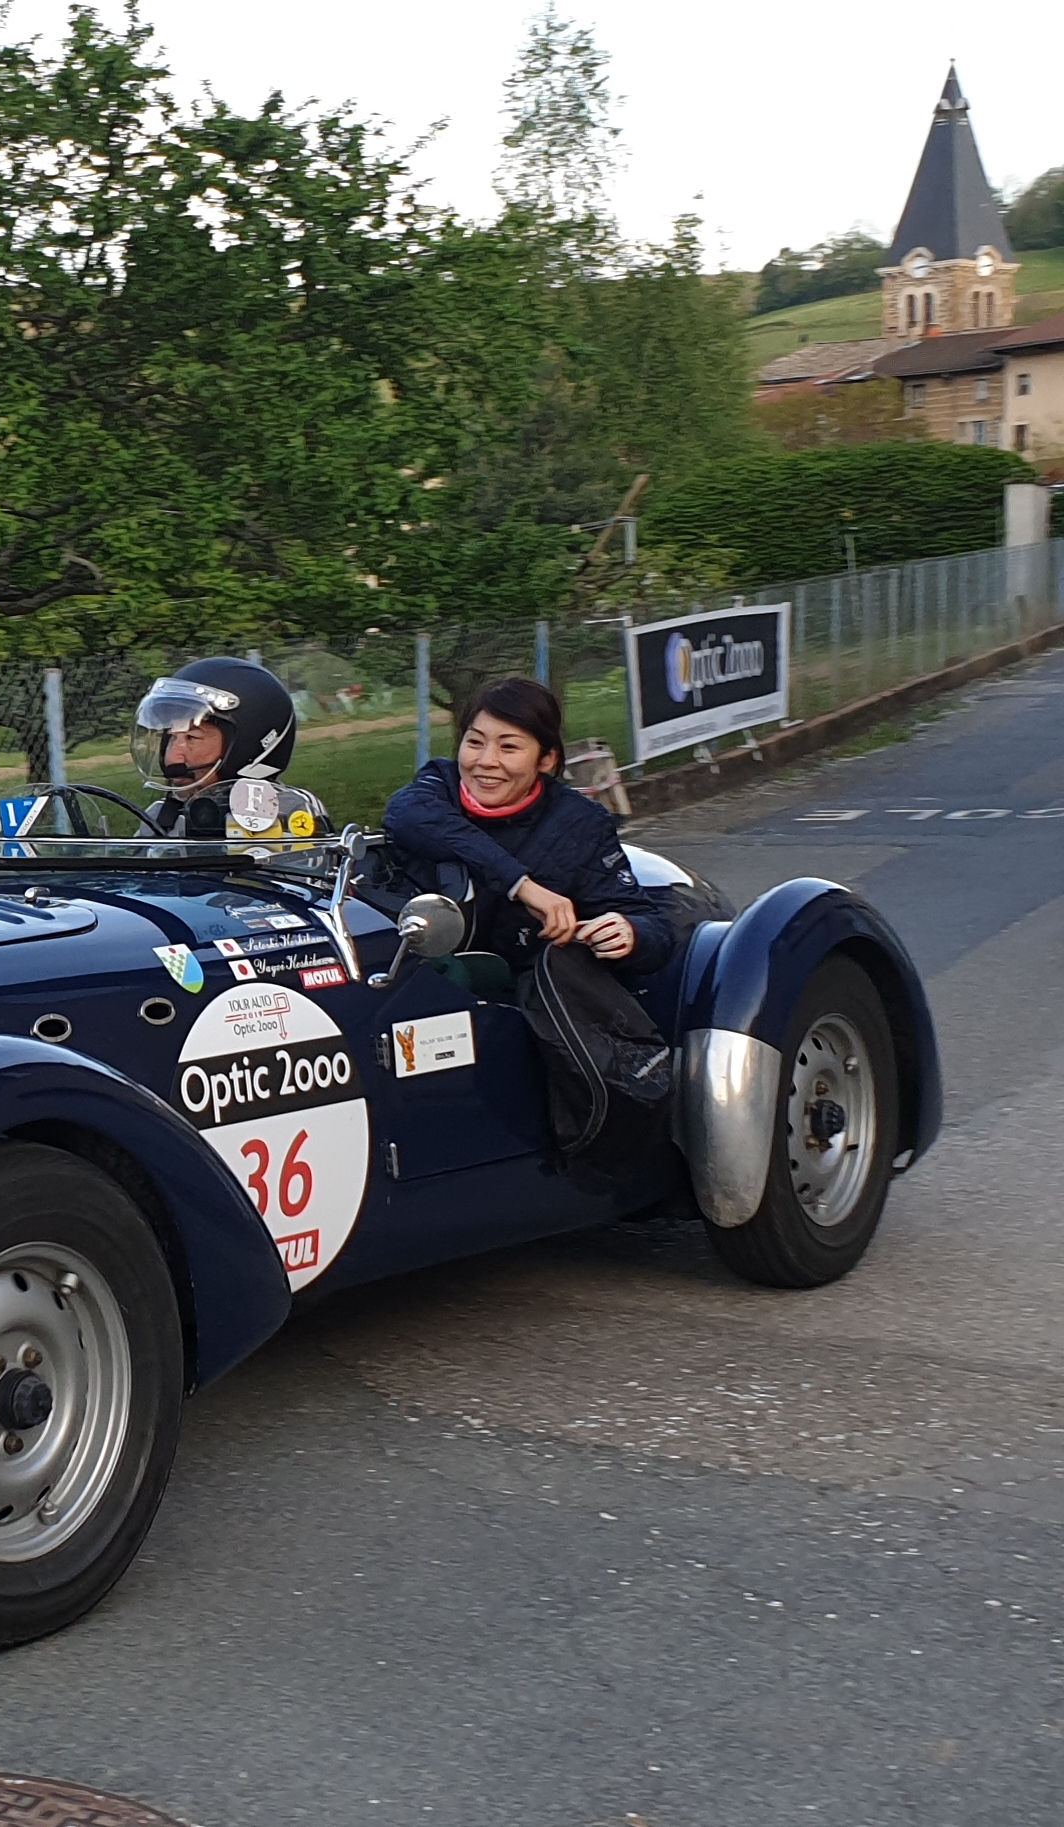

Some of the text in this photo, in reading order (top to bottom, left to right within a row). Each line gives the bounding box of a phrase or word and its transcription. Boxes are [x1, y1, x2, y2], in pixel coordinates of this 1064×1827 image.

[245, 783, 264, 812] F
[245, 816, 259, 829] 36
[302, 968, 344, 987] MOTUL
[228, 995, 272, 1012] TOUR AUTO
[243, 1010, 262, 1020] 2019
[233, 1020, 278, 1038] Optic 2000
[180, 1049, 351, 1123] Optic 2000
[240, 1129, 313, 1217] 36
[277, 1236, 315, 1267] TUL
